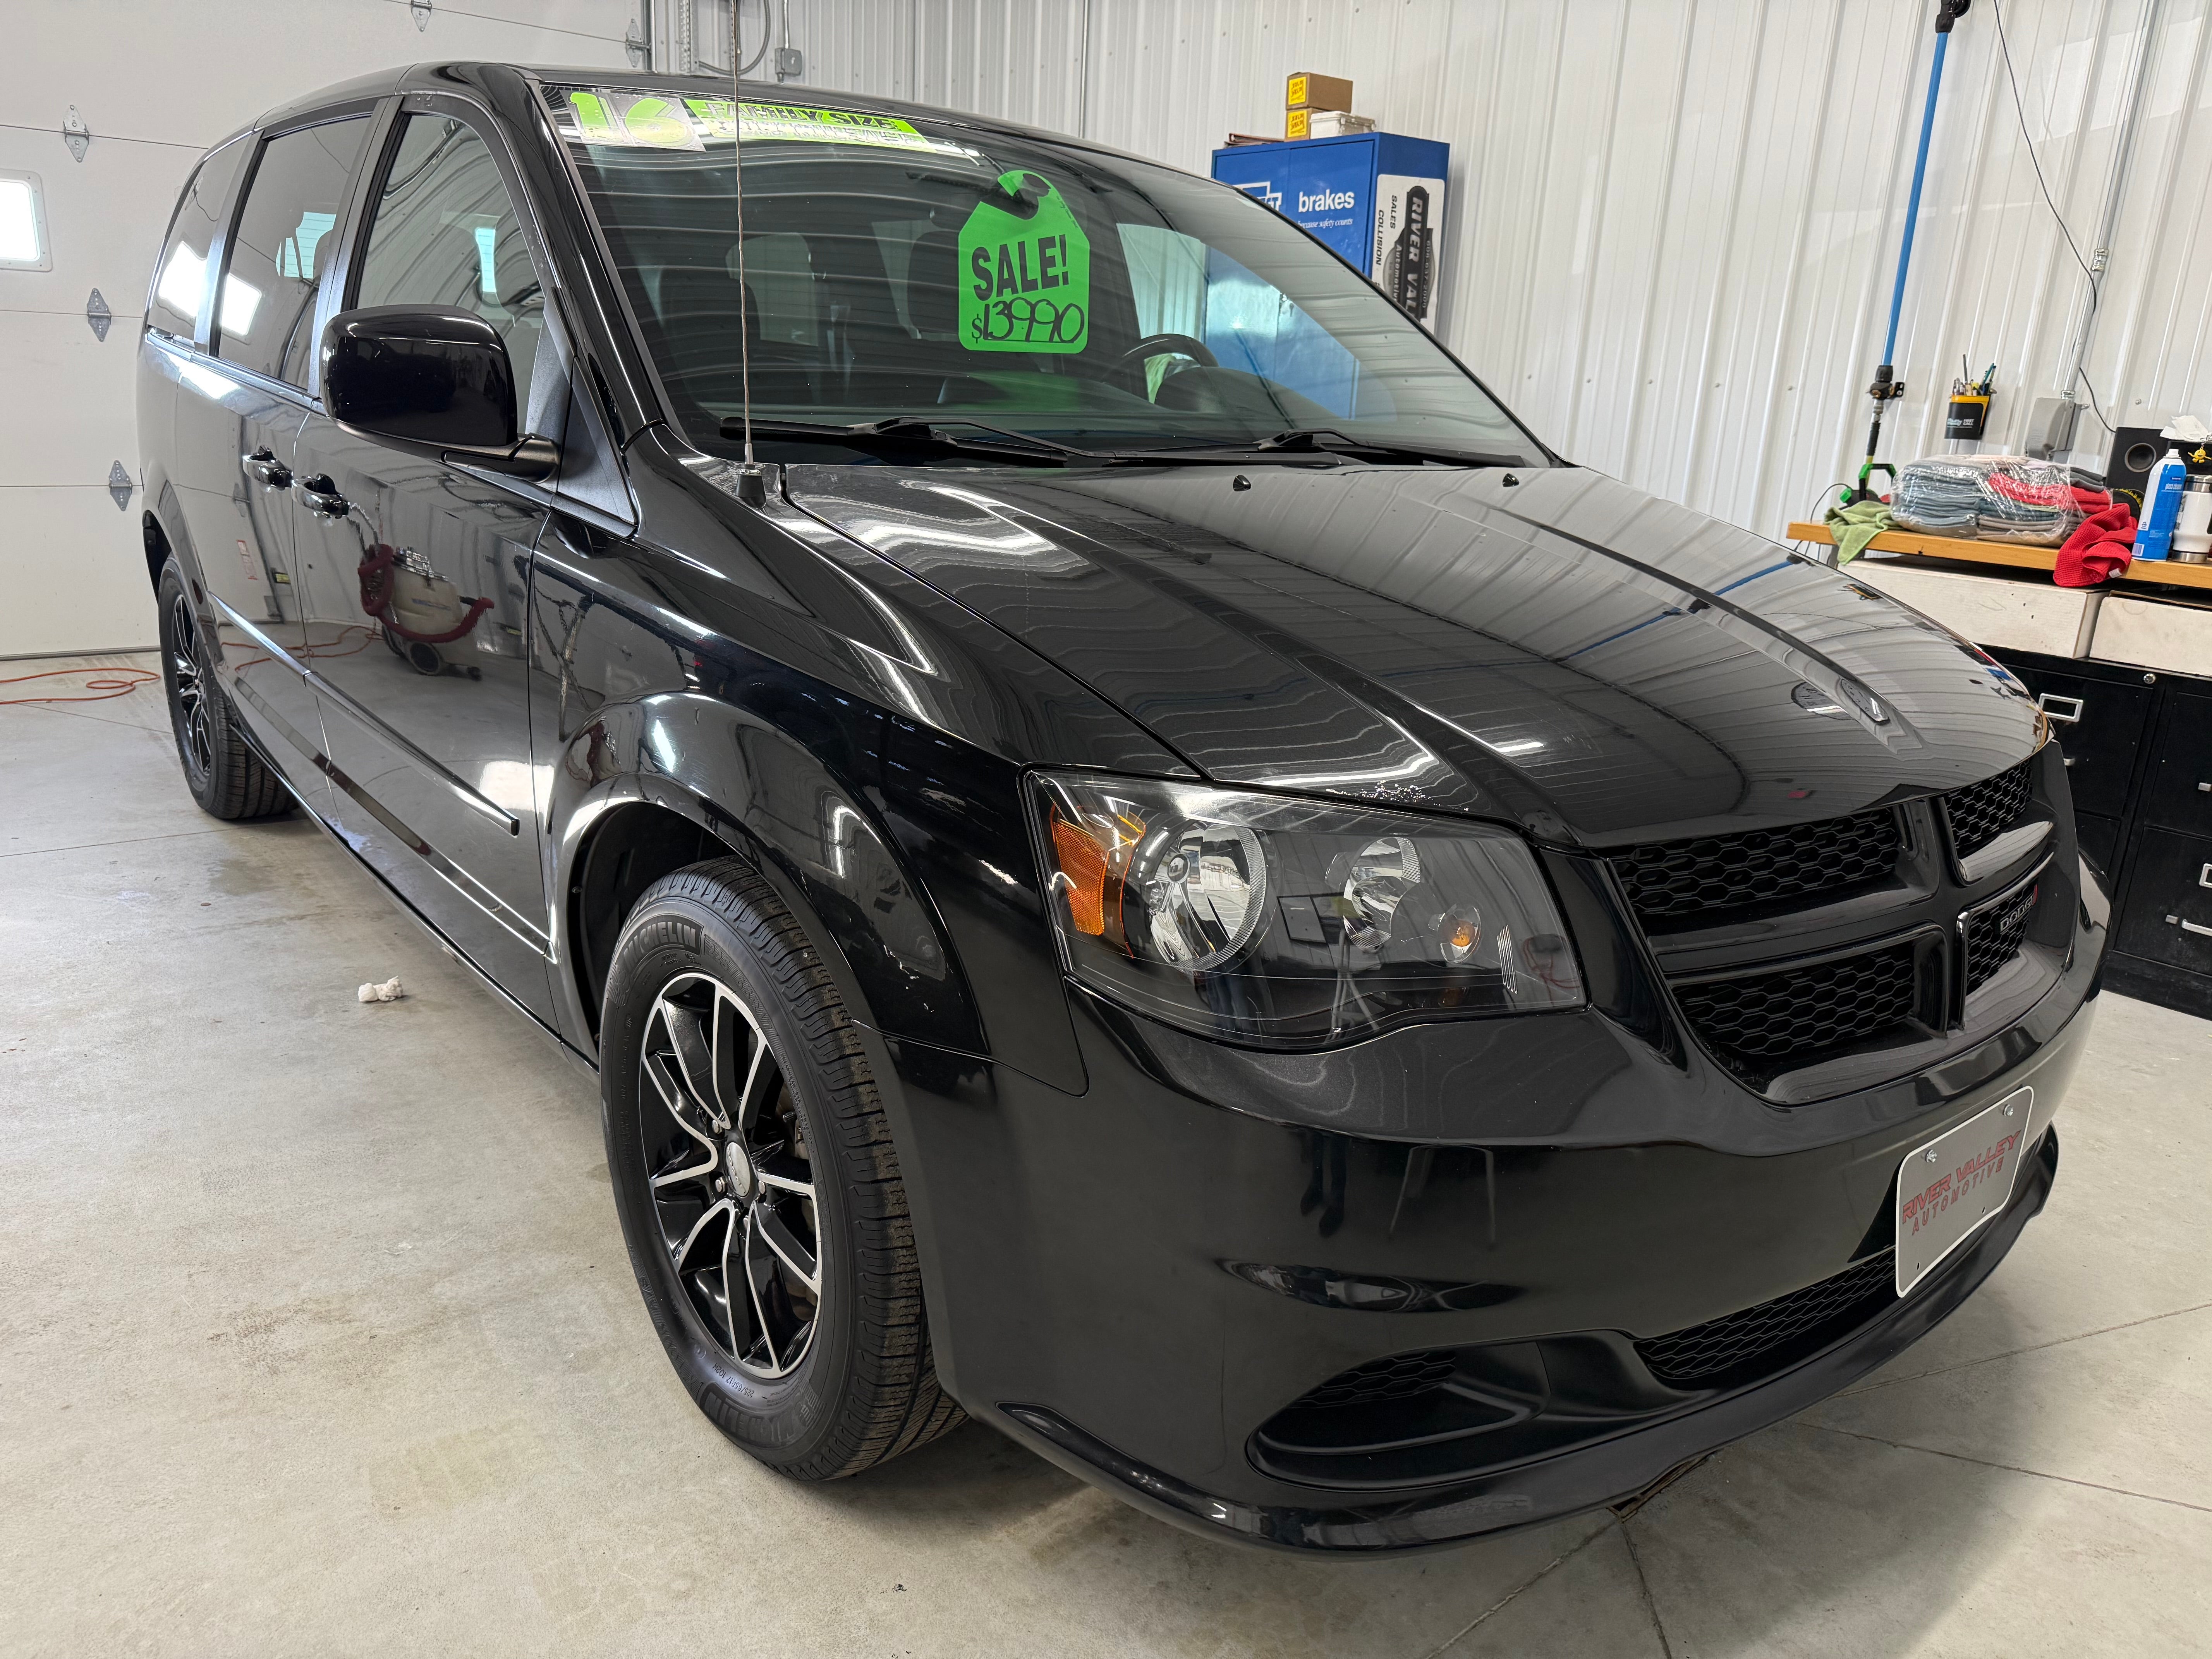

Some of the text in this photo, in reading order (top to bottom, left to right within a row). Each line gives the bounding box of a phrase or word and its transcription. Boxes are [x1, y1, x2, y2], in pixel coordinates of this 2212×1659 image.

[570, 92, 696, 147] 16
[705, 102, 902, 131] FAMILY SIZE
[1298, 189, 1355, 212] brakes
[1319, 218, 1334, 228] safety
[1376, 210, 1384, 265] COLLISION
[1405, 197, 1423, 317] RIVER VAL
[971, 234, 1069, 301] SALE!
[623, 921, 696, 964] MICHELIN
[1902, 1130, 2022, 1224] RIVER VALLEY
[1912, 1157, 2004, 1235] AUTOMOTIVE
[725, 1376, 755, 1398] 225/65R17
